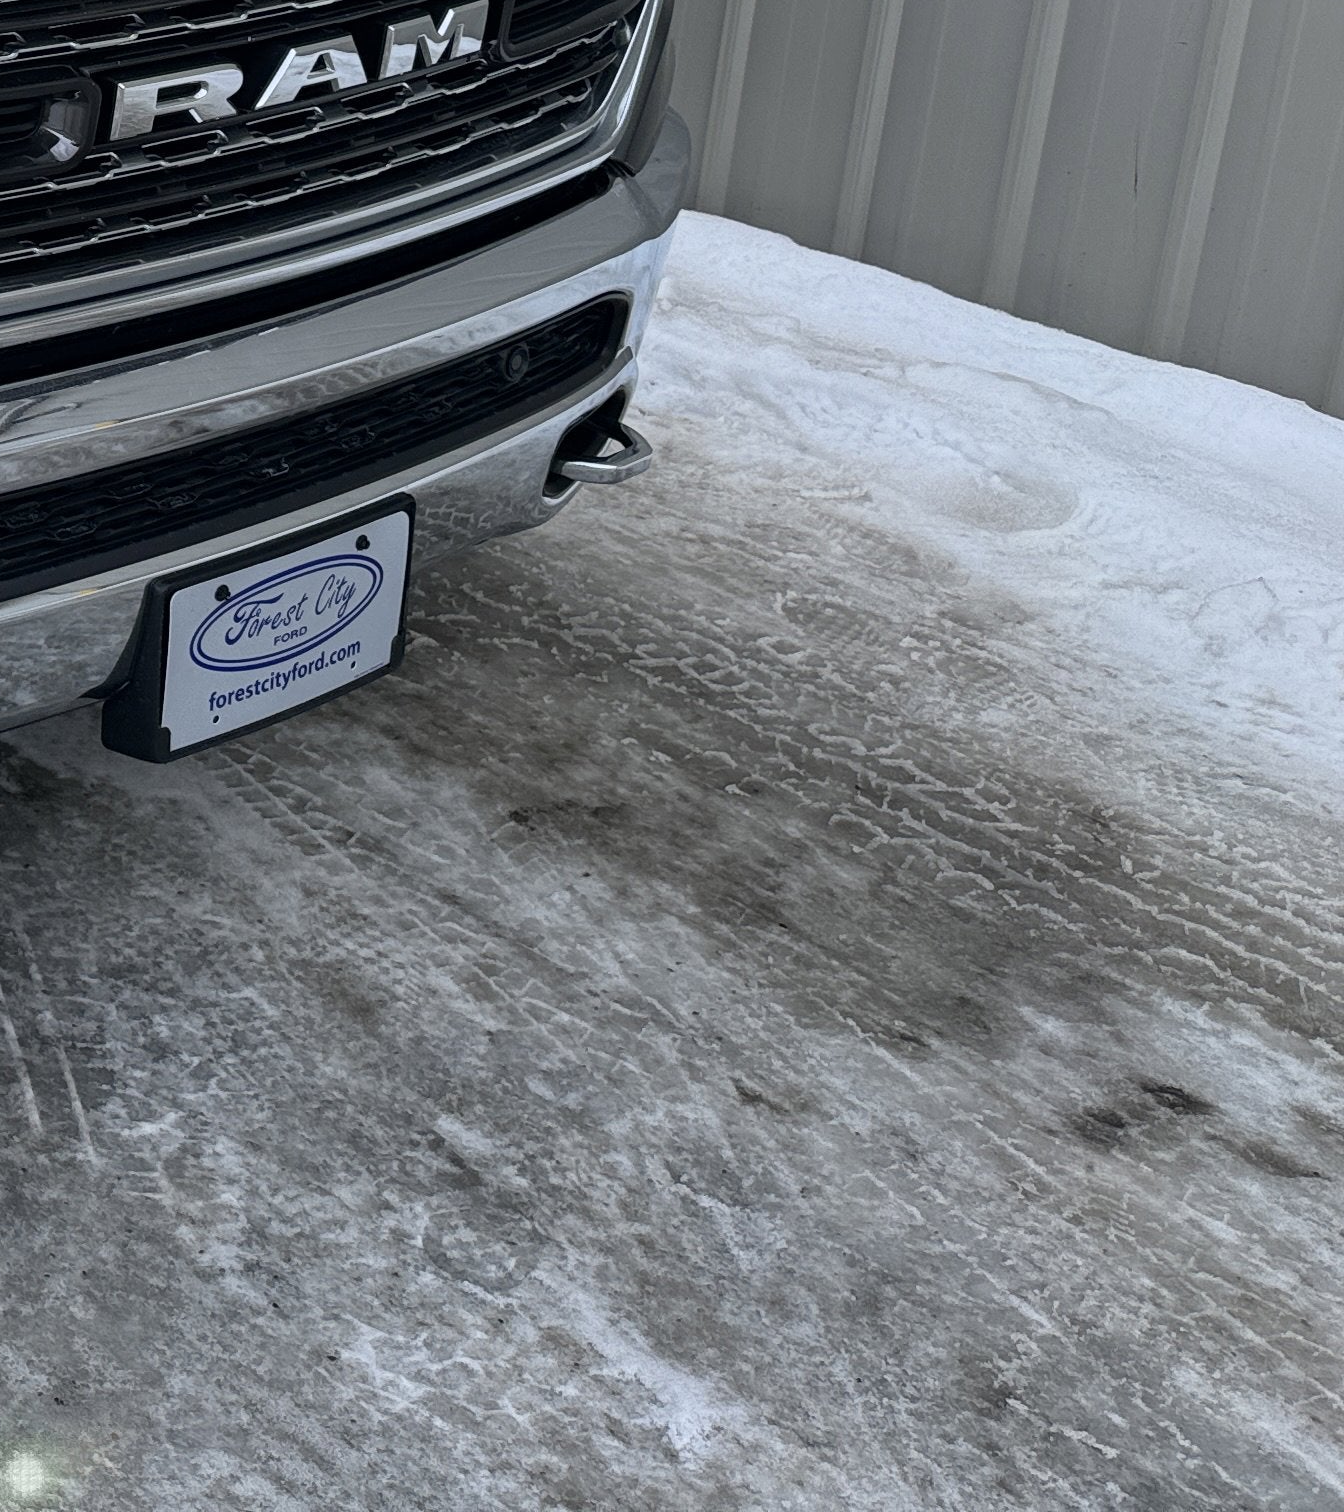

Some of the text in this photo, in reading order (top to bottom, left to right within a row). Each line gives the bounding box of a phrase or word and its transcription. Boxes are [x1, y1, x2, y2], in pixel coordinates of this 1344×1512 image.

[225, 574, 357, 645] Forest City
[273, 626, 308, 646] FORD
[209, 640, 361, 711] forestcityford.com
